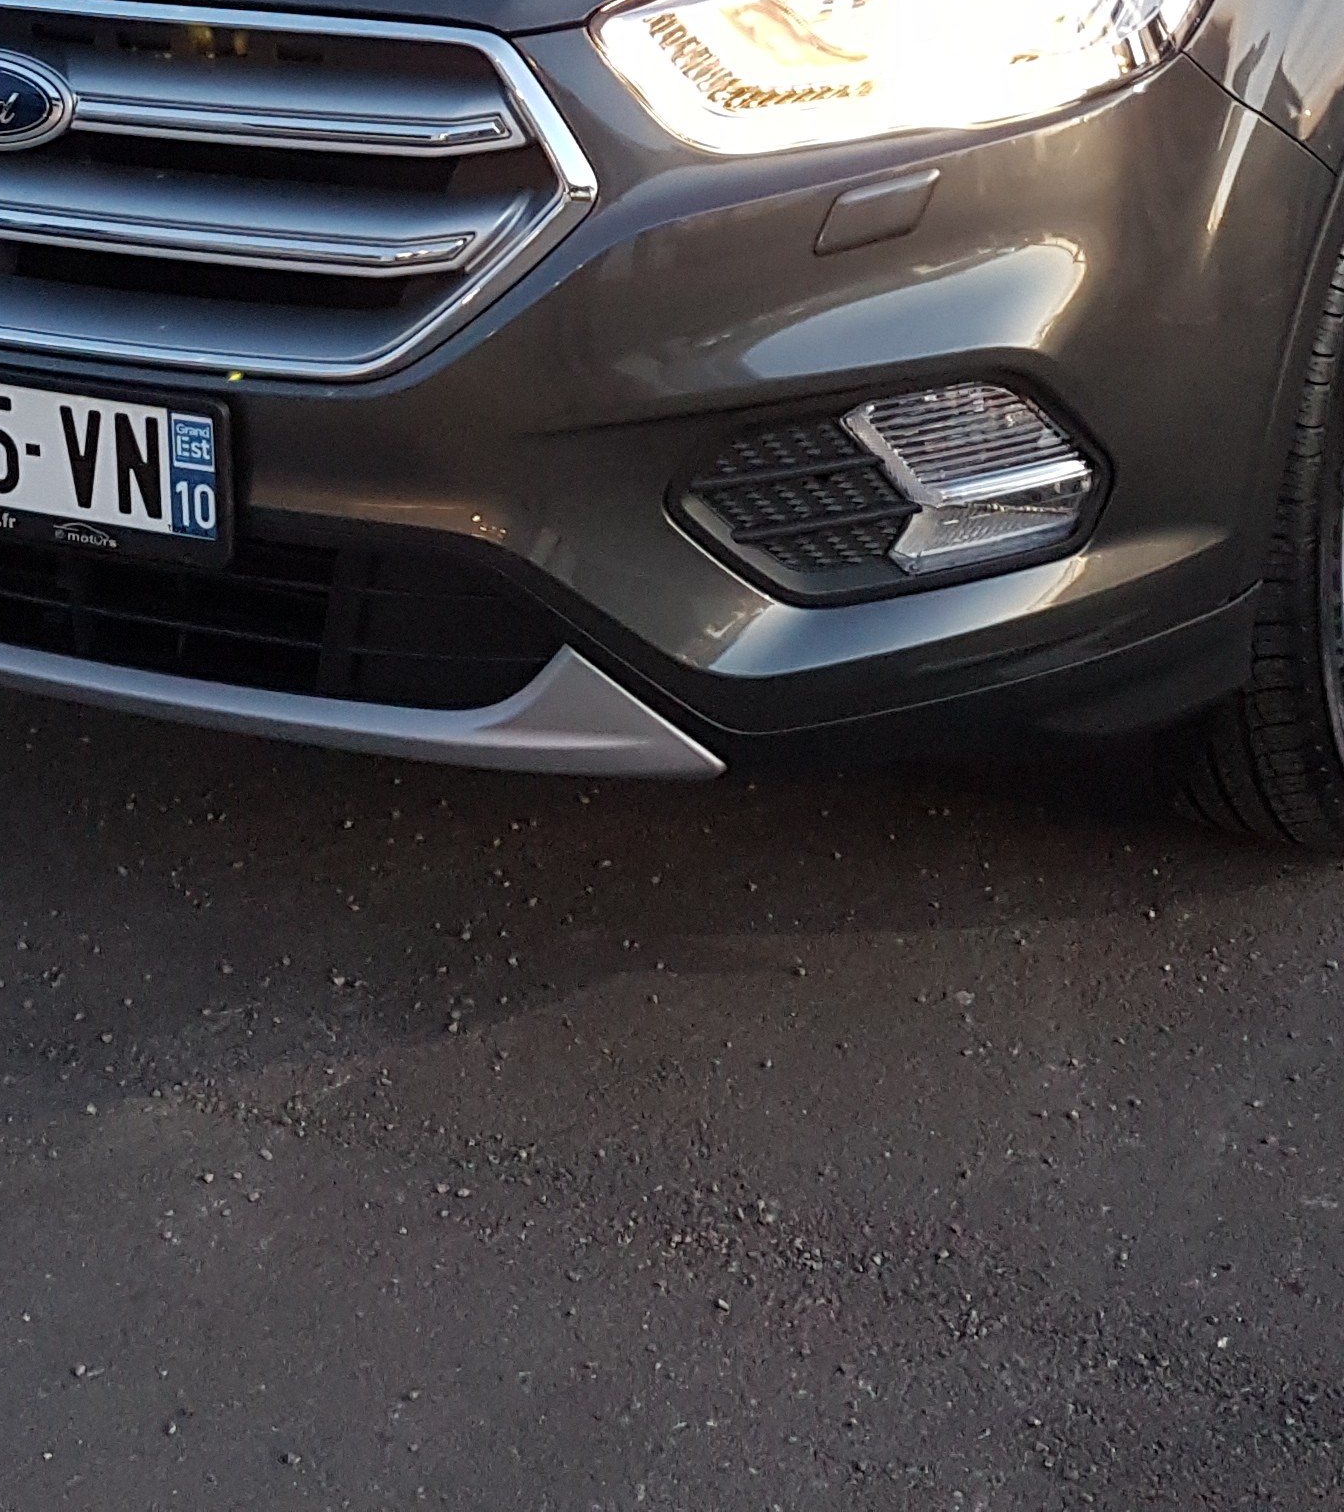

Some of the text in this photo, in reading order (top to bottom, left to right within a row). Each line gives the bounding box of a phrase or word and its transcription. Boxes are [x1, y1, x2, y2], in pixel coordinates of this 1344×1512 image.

[175, 423, 210, 439] Grand
[176, 435, 211, 460] Est
[175, 480, 216, 530] 10
